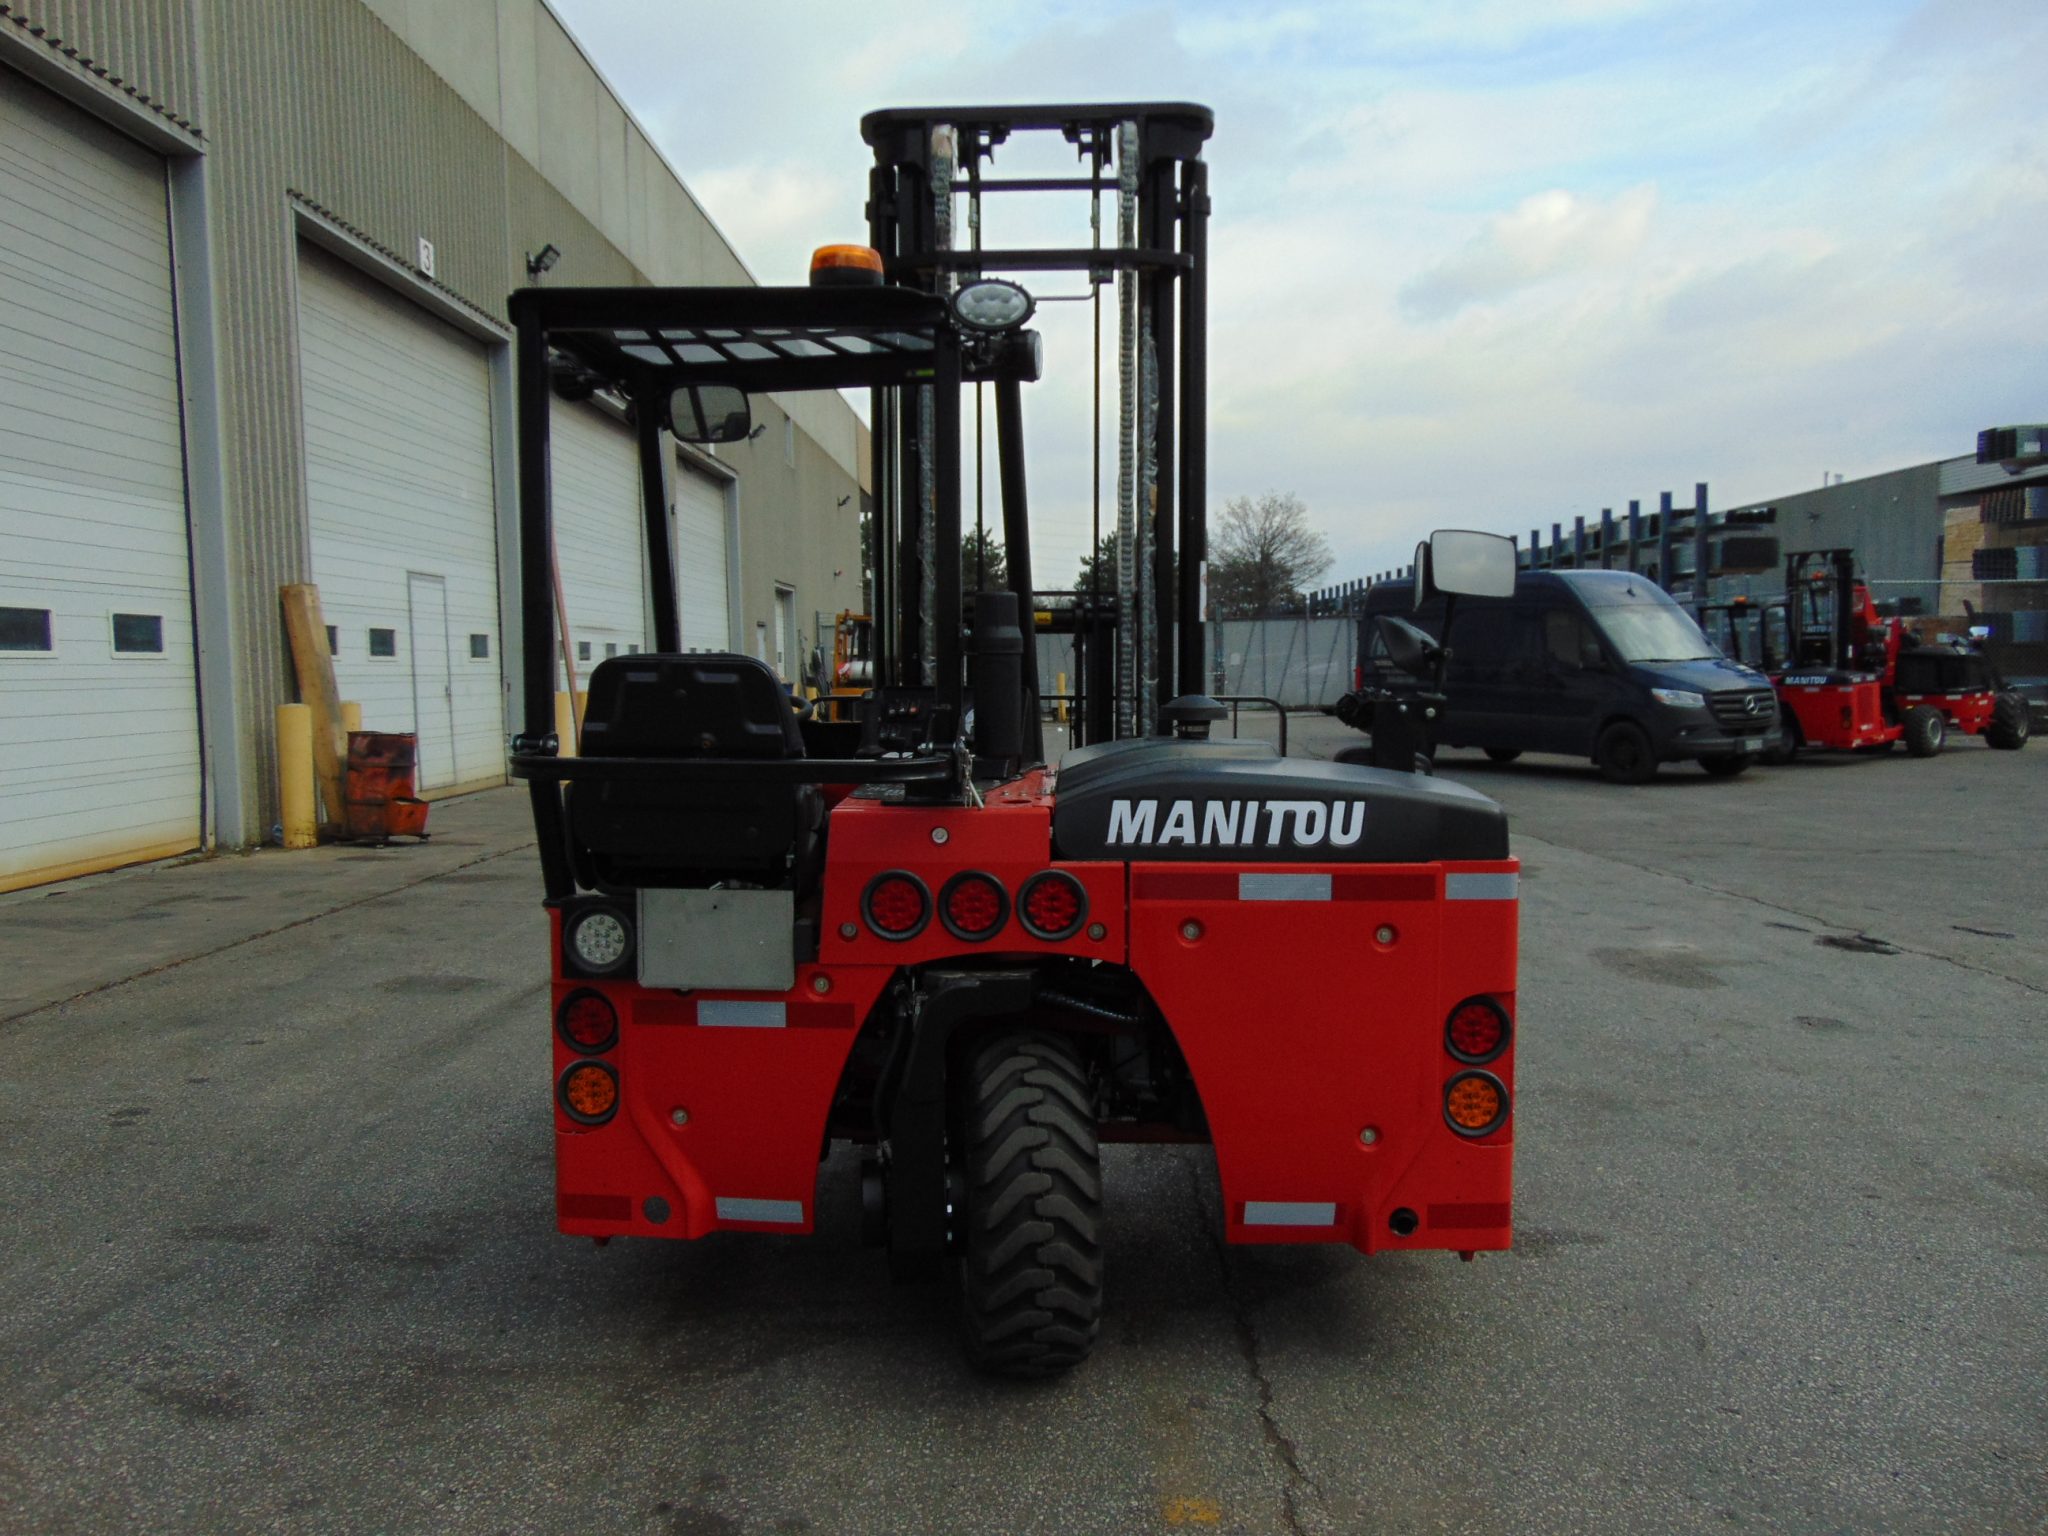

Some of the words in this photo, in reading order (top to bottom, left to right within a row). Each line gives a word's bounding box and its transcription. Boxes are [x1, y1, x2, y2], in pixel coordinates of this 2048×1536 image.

[423, 243, 431, 270] 3
[1784, 675, 1827, 684] MANITOU
[1106, 799, 1365, 846] MANITOU
